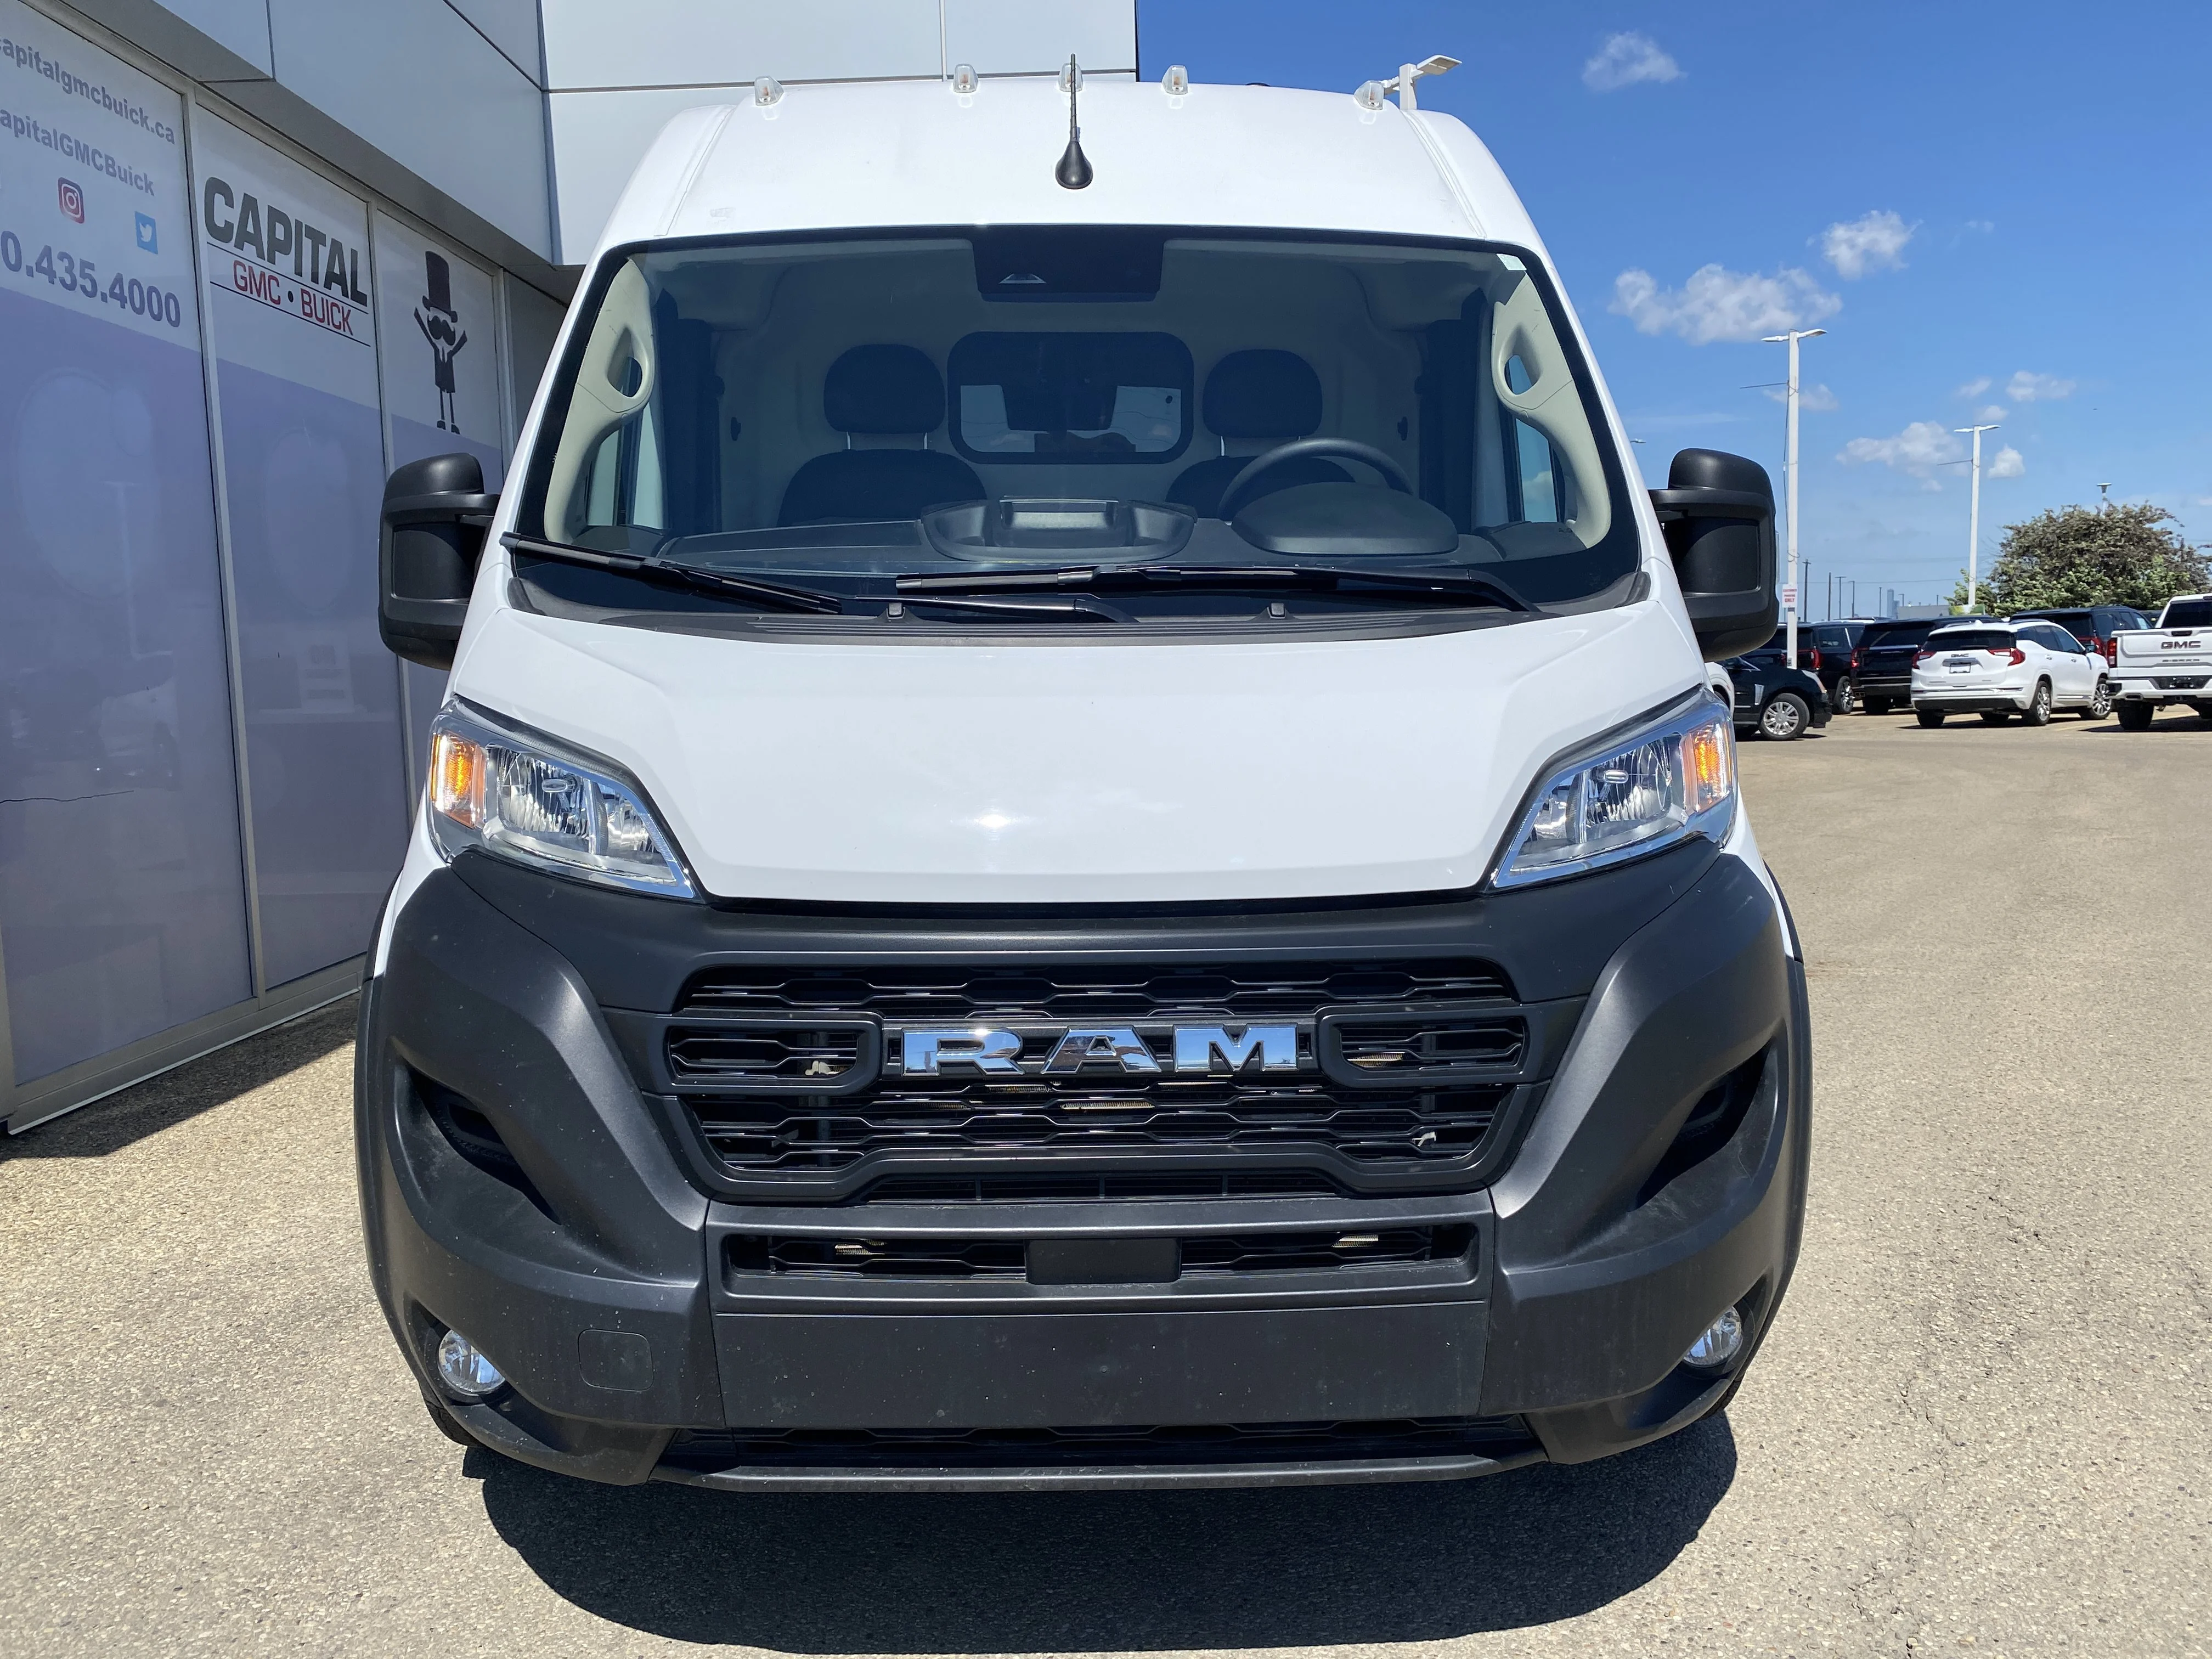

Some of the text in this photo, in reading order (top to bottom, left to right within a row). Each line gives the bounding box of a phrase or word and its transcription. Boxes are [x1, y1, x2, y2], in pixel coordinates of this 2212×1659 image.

[0, 38, 175, 144] apitalgmcbuick.ca
[1, 230, 180, 328] 0.435.4000
[204, 177, 368, 307] CAPITAL
[233, 260, 353, 336] GMC BUICK
[2162, 641, 2201, 649] GMC
[901, 1024, 1299, 1076] RAM
